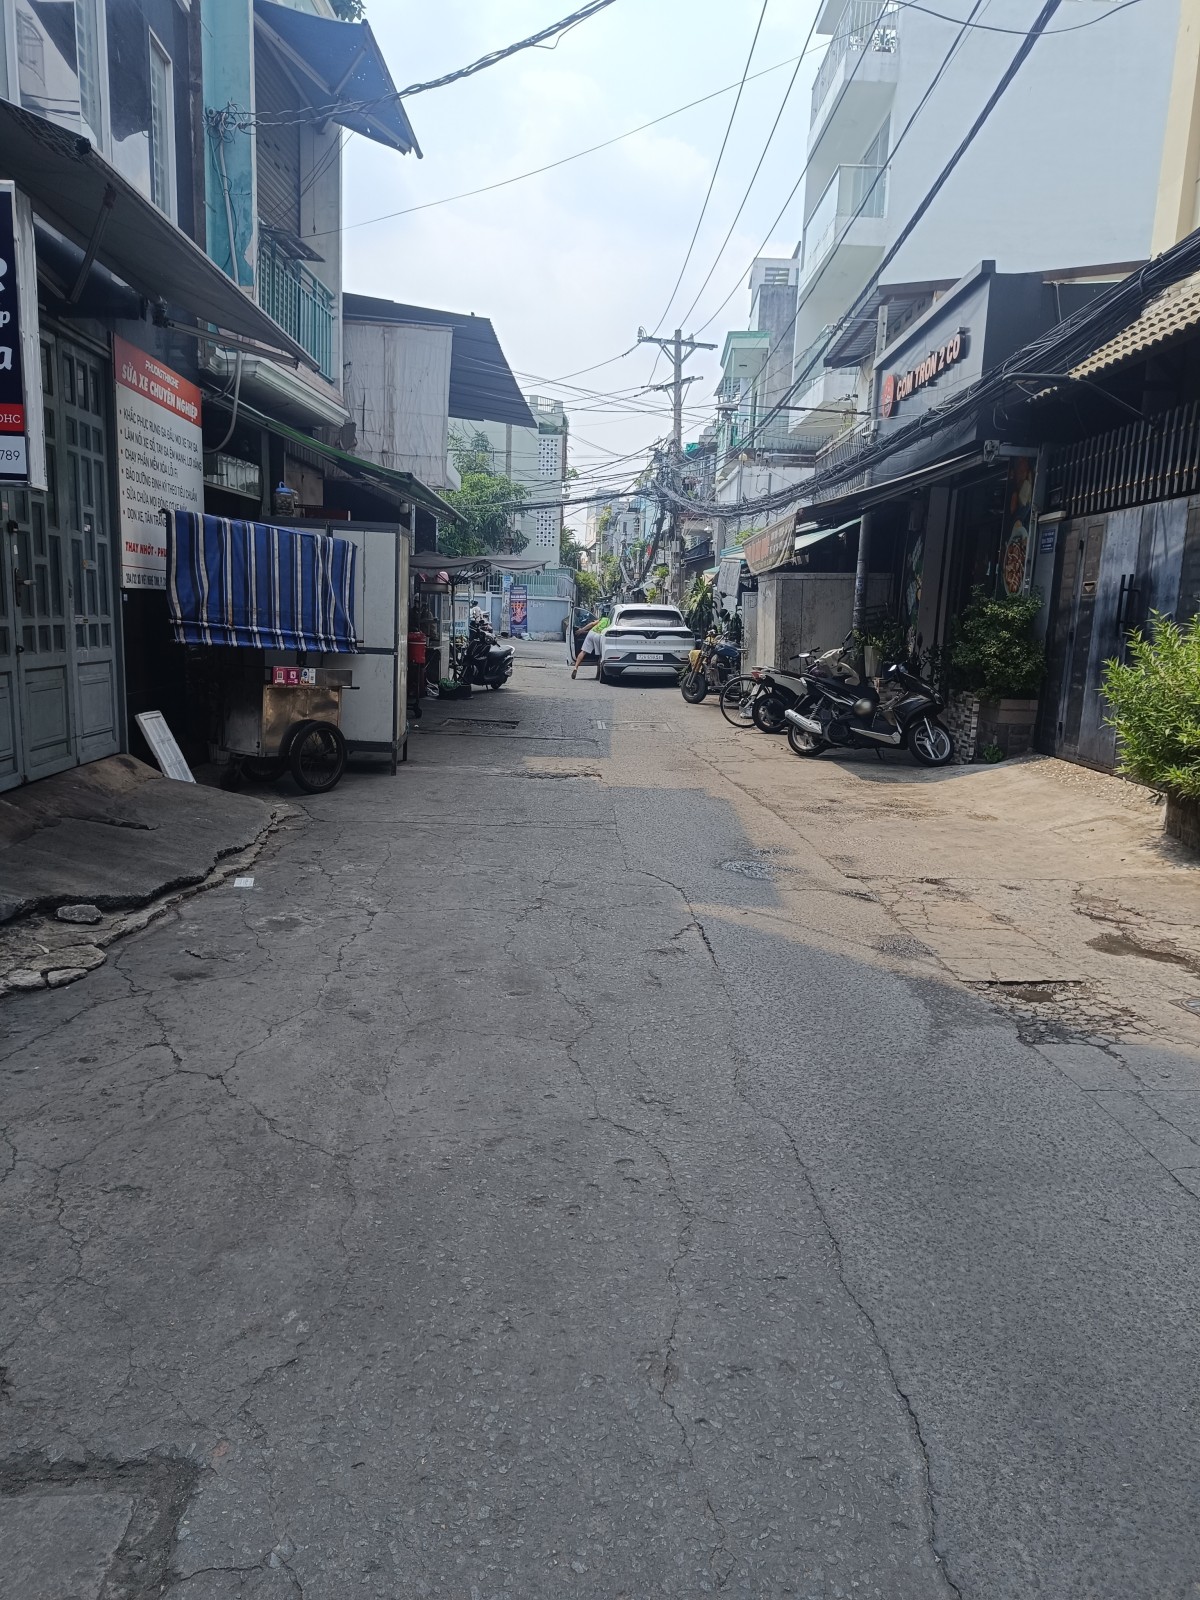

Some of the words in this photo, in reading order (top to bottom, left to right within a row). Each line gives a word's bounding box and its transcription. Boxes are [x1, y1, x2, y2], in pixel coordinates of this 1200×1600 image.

[938, 346, 946, 372] 2
[121, 361, 137, 386] SỬA
[138, 373, 148, 392] XE
[150, 380, 175, 408] CHUYÊN
[176, 396, 198, 422] NGHIỆP
[125, 542, 139, 553] THAY
